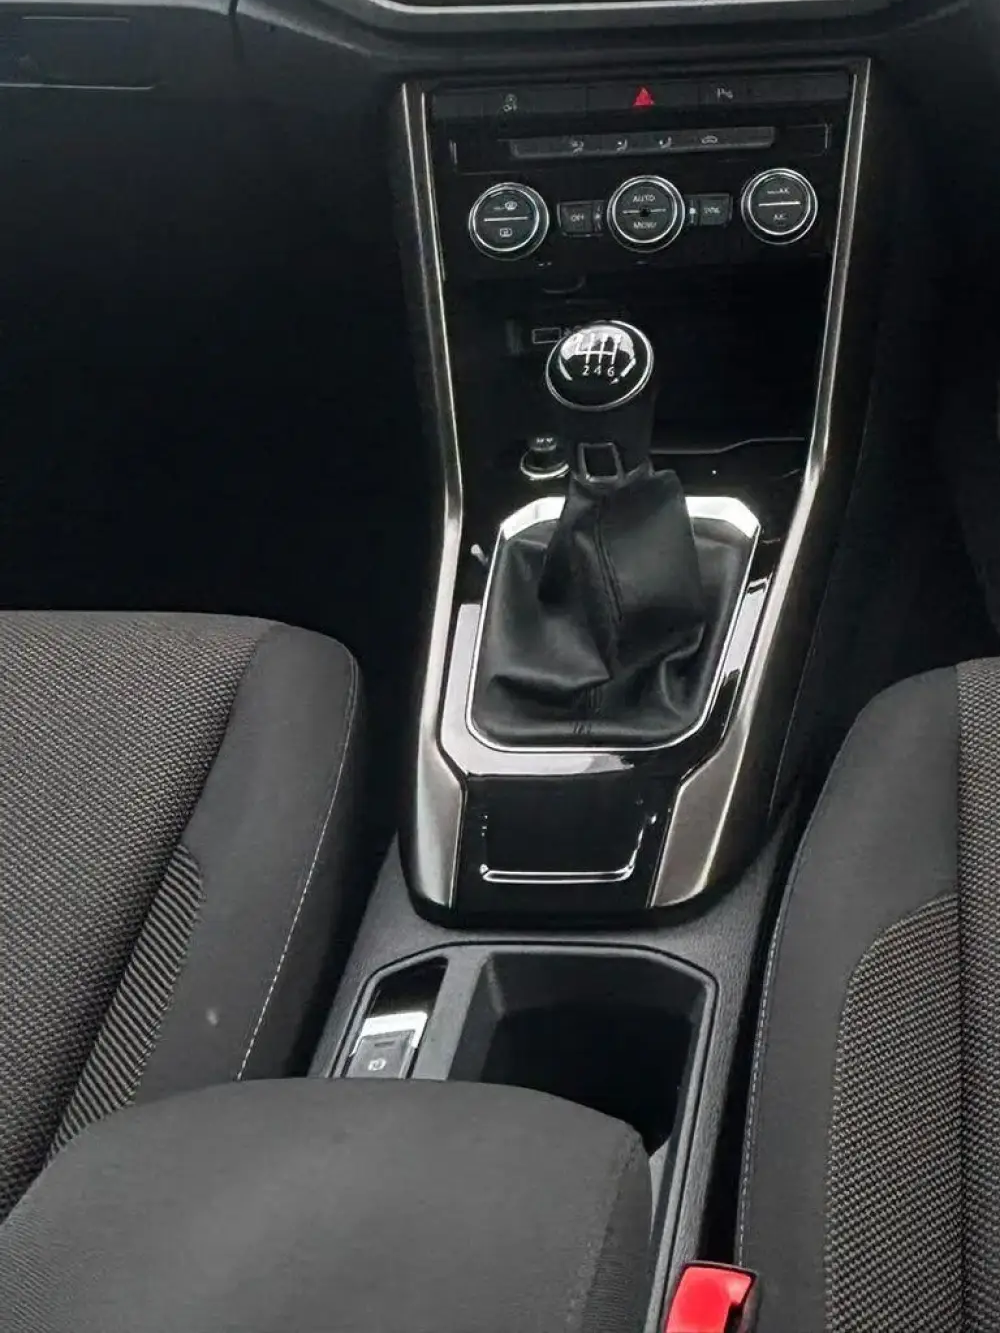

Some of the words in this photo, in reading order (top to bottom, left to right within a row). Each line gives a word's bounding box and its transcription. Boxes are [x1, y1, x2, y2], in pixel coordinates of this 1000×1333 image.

[632, 193, 656, 203] AUTO
[582, 366, 589, 377] 2
[594, 367, 602, 377] 4
[607, 367, 615, 377] 6
